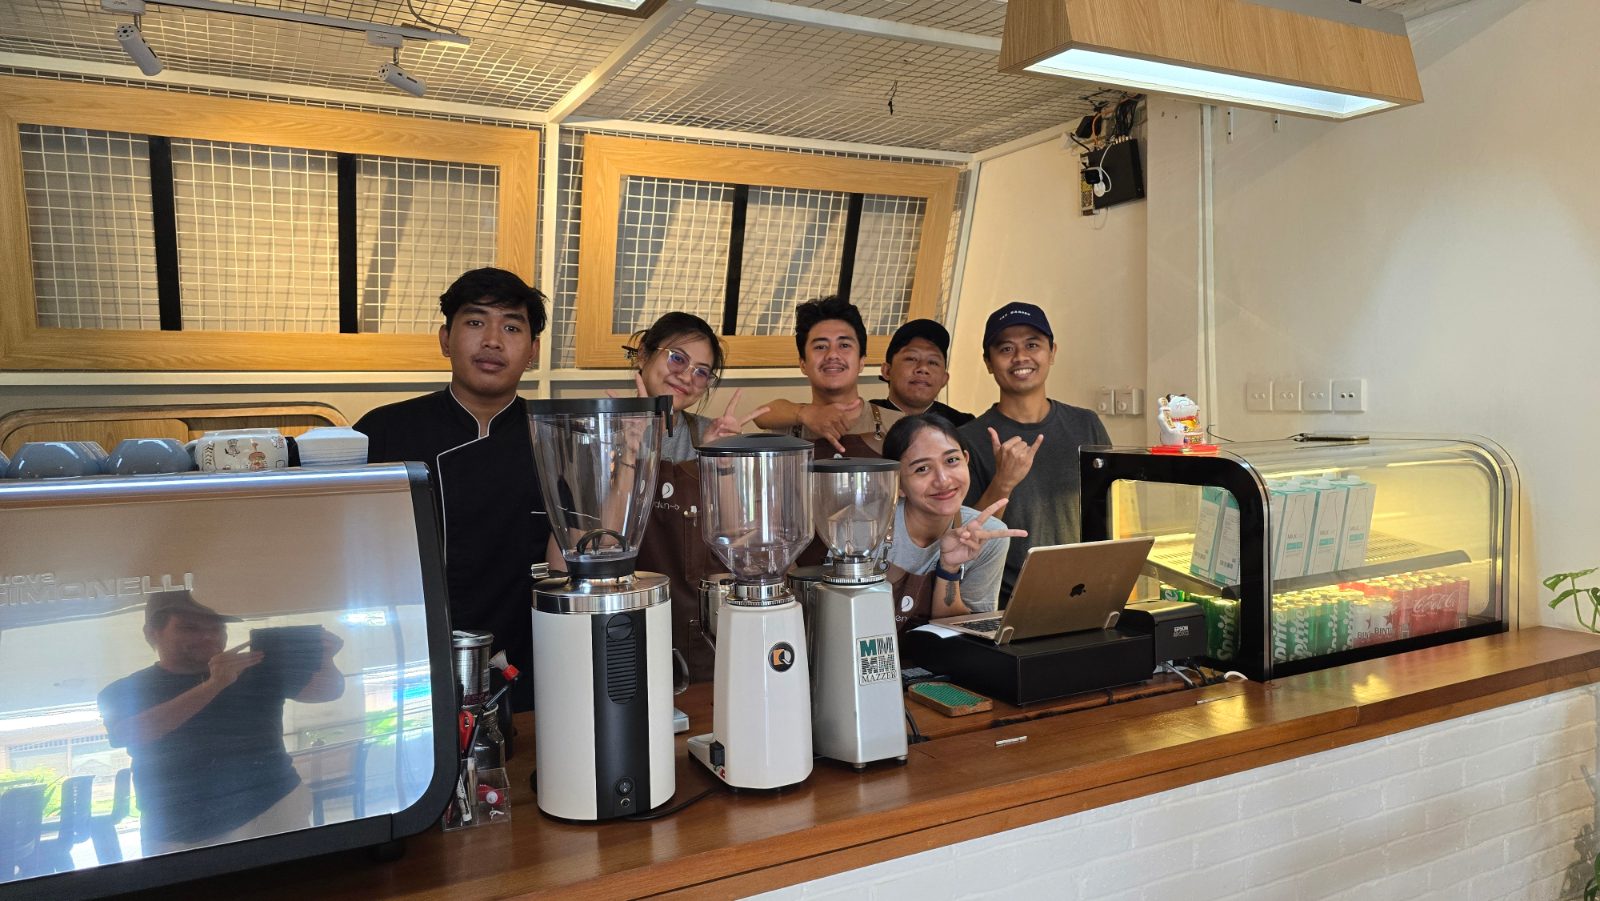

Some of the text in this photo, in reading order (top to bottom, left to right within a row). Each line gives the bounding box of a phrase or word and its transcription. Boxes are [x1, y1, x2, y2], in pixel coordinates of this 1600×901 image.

[1217, 604, 1236, 661] Sprite
[1271, 612, 1288, 661] prite
[861, 670, 897, 683] MAZZER
